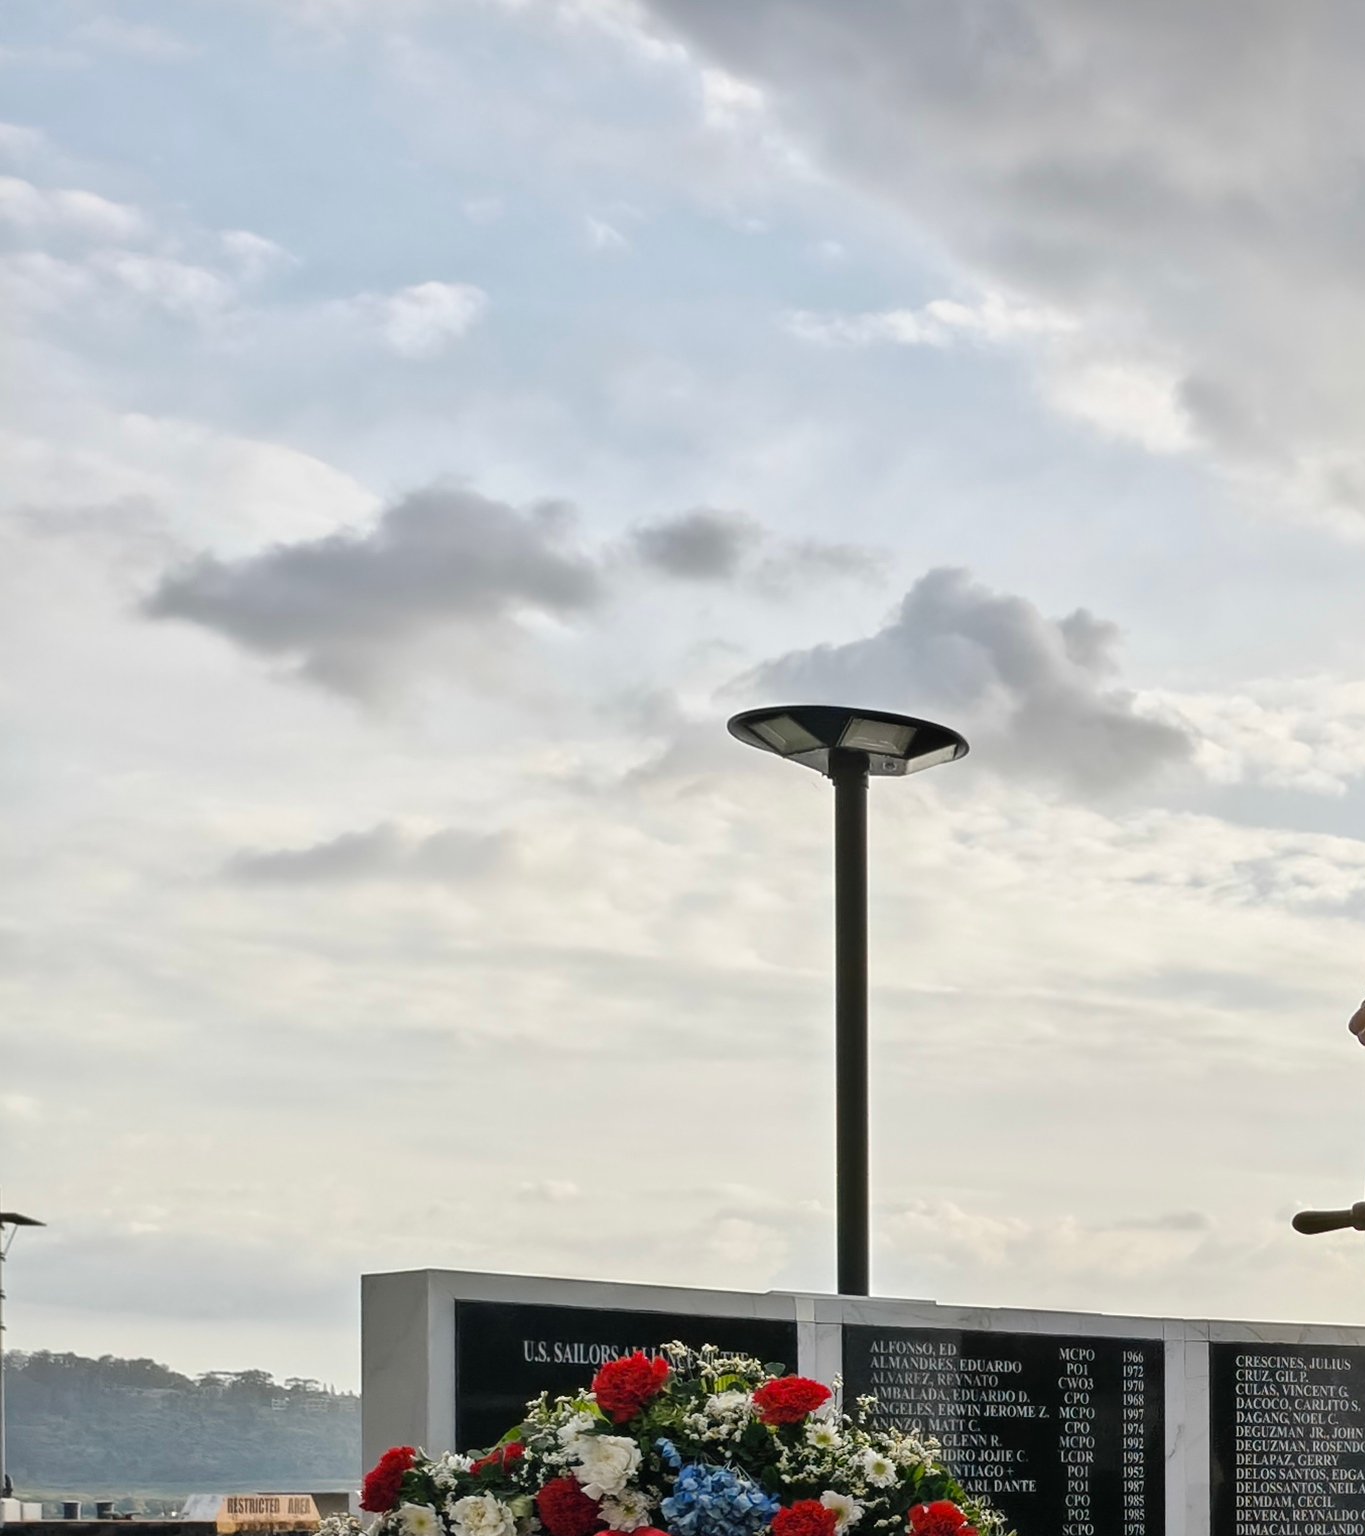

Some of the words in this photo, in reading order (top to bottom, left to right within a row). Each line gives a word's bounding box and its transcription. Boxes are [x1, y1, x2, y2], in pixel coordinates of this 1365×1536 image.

[523, 1340, 550, 1362] U.S.
[870, 1341, 936, 1357] ALFONSO,
[939, 1343, 957, 1356] ED
[1059, 1348, 1095, 1361] MCPO
[1122, 1350, 1144, 1363] 1966
[870, 1356, 957, 1372] ALMANDRES,
[960, 1359, 1022, 1374] EDUARDO
[1066, 1363, 1088, 1376] PO1
[1122, 1365, 1144, 1378] 1972
[1235, 1355, 1307, 1371] CRESCINES,
[1309, 1359, 1351, 1371] JULIUS
[938, 1373, 998, 1387] REYNATO
[1058, 1376, 1094, 1389] CWO3
[1122, 1379, 1144, 1392] 1970
[1236, 1398, 1292, 1411] DACOCO,
[1294, 1399, 1349, 1411] CARLITO
[1351, 1400, 1361, 1412] S.
[1236, 1440, 1310, 1454] DEGUZMAN,
[1297, 1454, 1340, 1466] GERRY
[227, 1497, 280, 1514] RESTRICTED
[287, 1497, 311, 1514] AREA
[1236, 1496, 1295, 1509] DEMDAM,
[1297, 1496, 1335, 1508] CECIL
